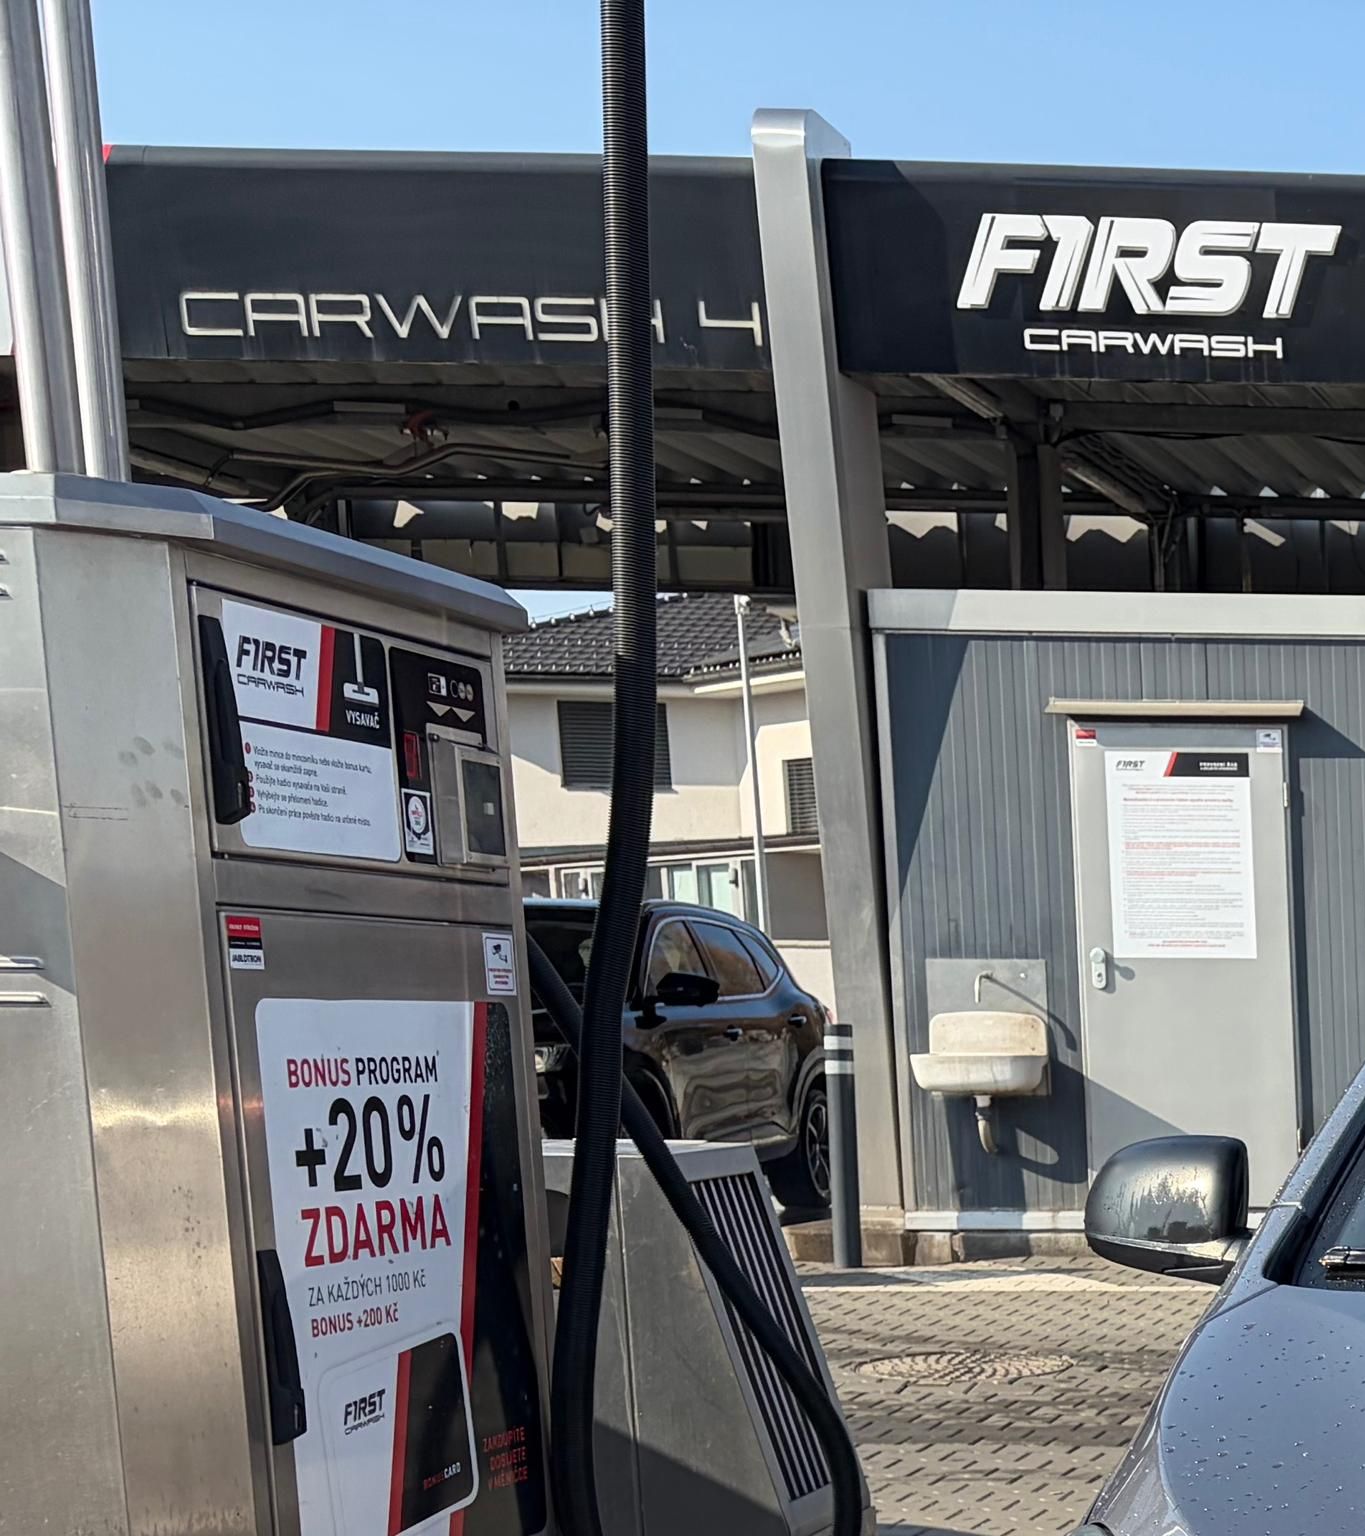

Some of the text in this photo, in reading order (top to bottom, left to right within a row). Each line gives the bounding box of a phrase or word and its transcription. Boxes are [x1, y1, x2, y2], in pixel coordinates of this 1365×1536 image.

[698, 300, 763, 346] 4
[1023, 327, 1284, 359] CARWASH
[237, 673, 305, 697] CARWASH
[345, 709, 380, 729] VYSAVAČ
[286, 1054, 439, 1089] BONUS PROGRAM
[295, 1093, 446, 1193] +20%
[300, 1193, 451, 1268] ZDARMA
[308, 1268, 427, 1307] ZA KAŽDÝCH 1000 Kč
[310, 1302, 399, 1338] BONUS +200 Kč
